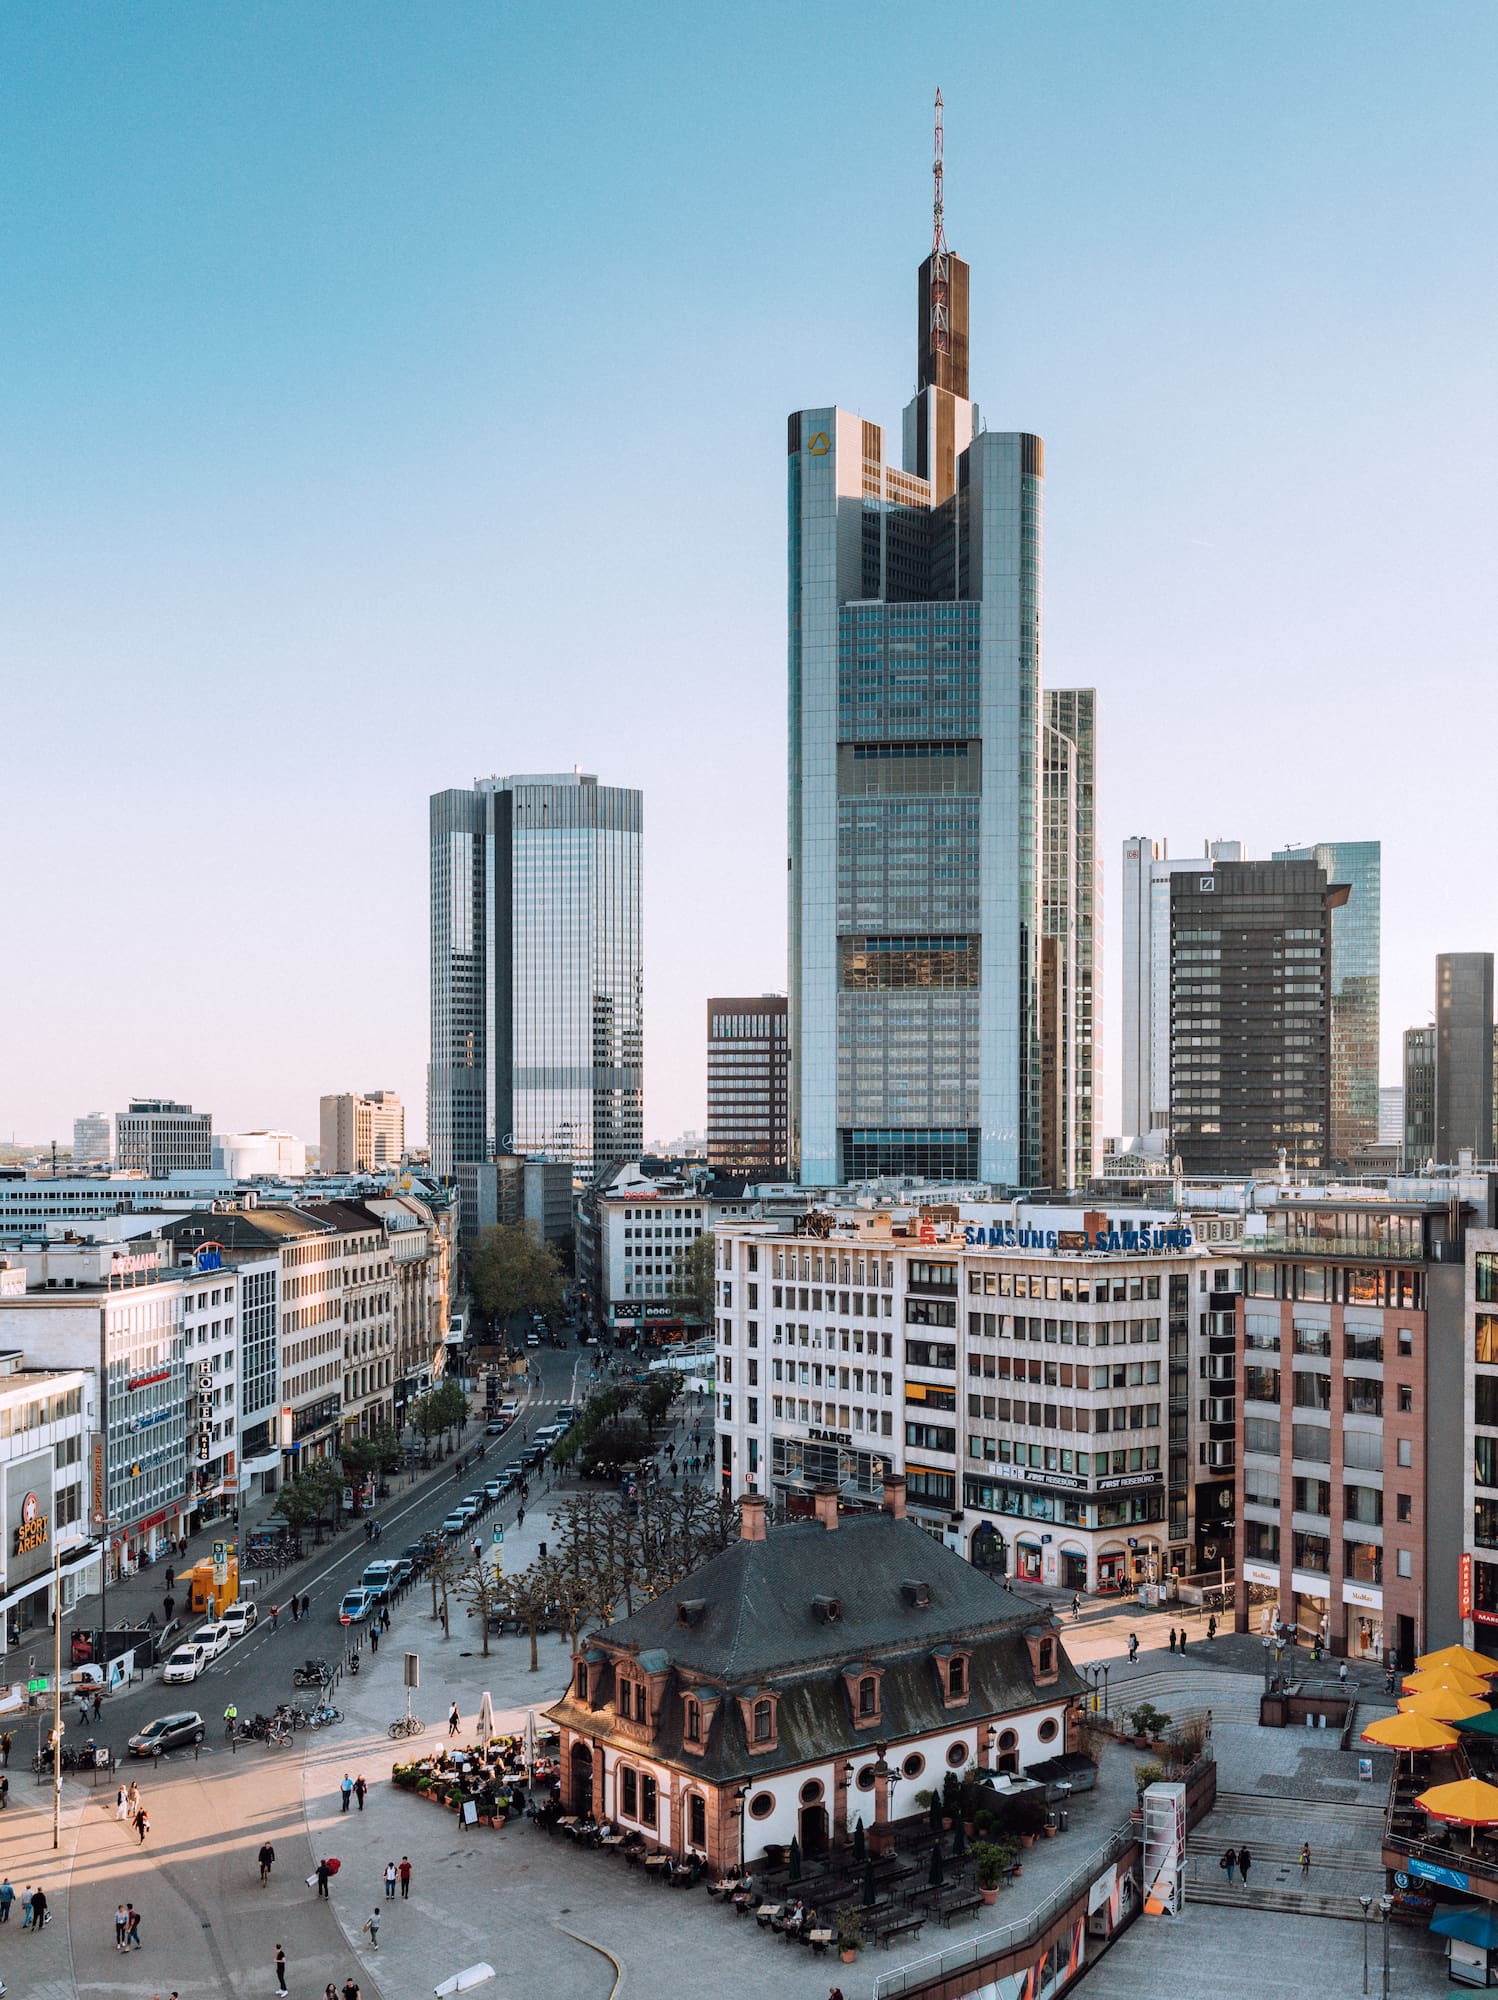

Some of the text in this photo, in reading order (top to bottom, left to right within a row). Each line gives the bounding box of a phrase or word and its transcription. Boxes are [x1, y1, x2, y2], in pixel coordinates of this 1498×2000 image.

[965, 1227, 1057, 1249] SAMSUNG
[1095, 1228, 1192, 1250] SAMSUNG
[200, 1362, 212, 1432] HOTEL
[808, 1428, 852, 1445] PRANGE
[19, 1515, 48, 1540] SPORT
[494, 1533, 502, 1542] U
[18, 1532, 48, 1555] ARENA
[215, 1544, 221, 1552] S
[214, 1553, 222, 1563] U
